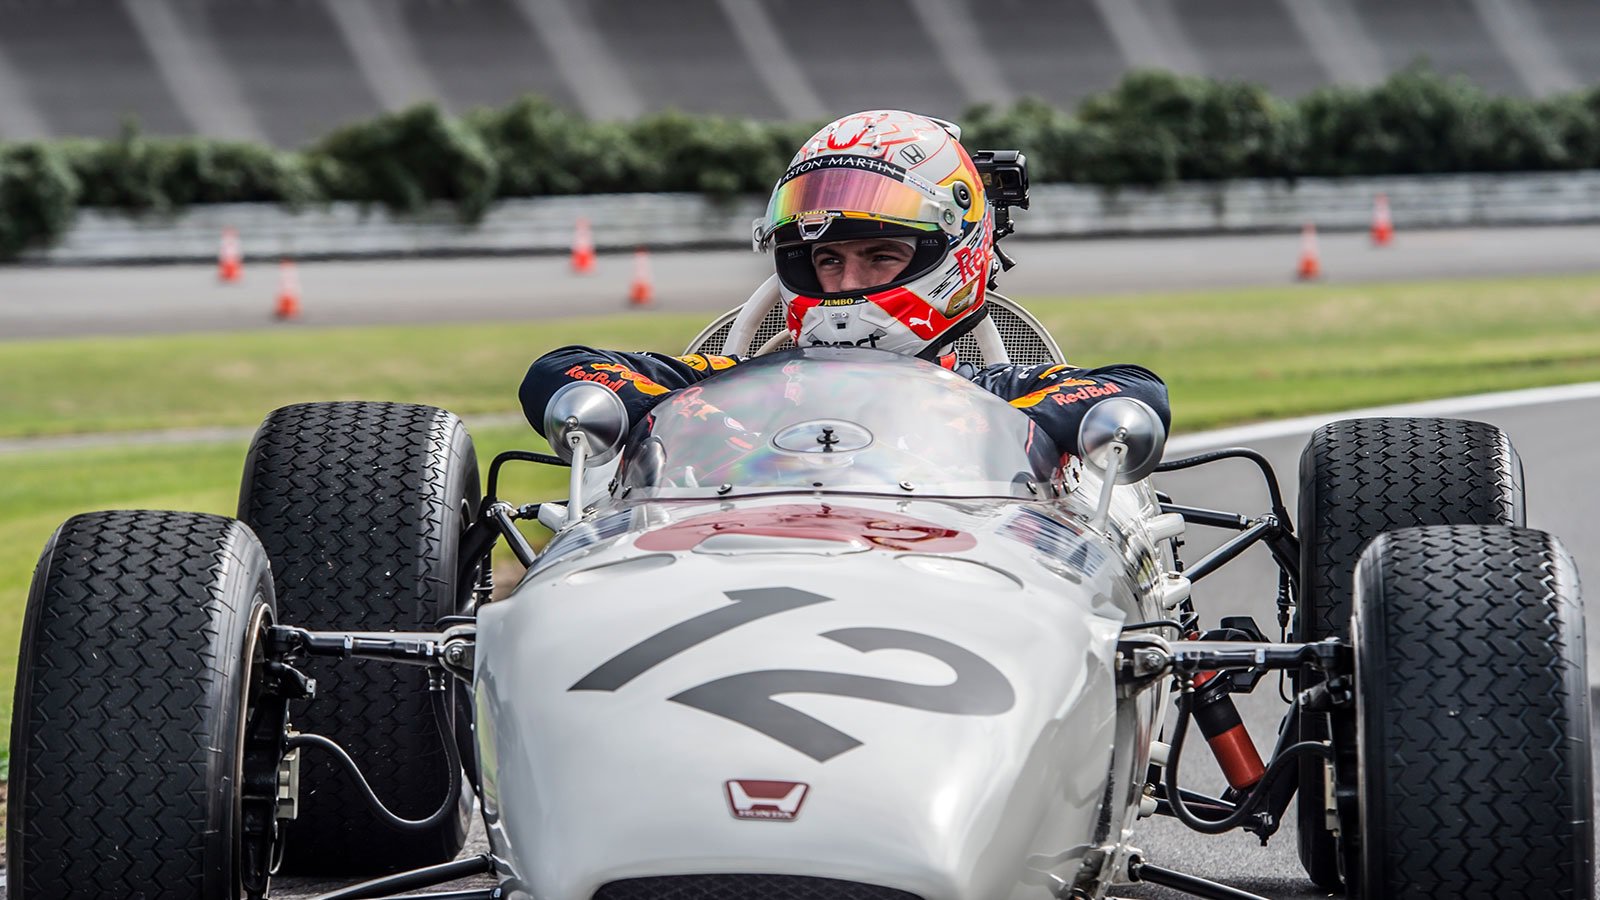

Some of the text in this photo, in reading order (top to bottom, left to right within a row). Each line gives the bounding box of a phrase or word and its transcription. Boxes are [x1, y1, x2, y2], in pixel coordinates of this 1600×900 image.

[782, 157, 896, 183] ASTON MARTIN
[824, 298, 853, 306] JUMBO
[567, 586, 1015, 763] 12
